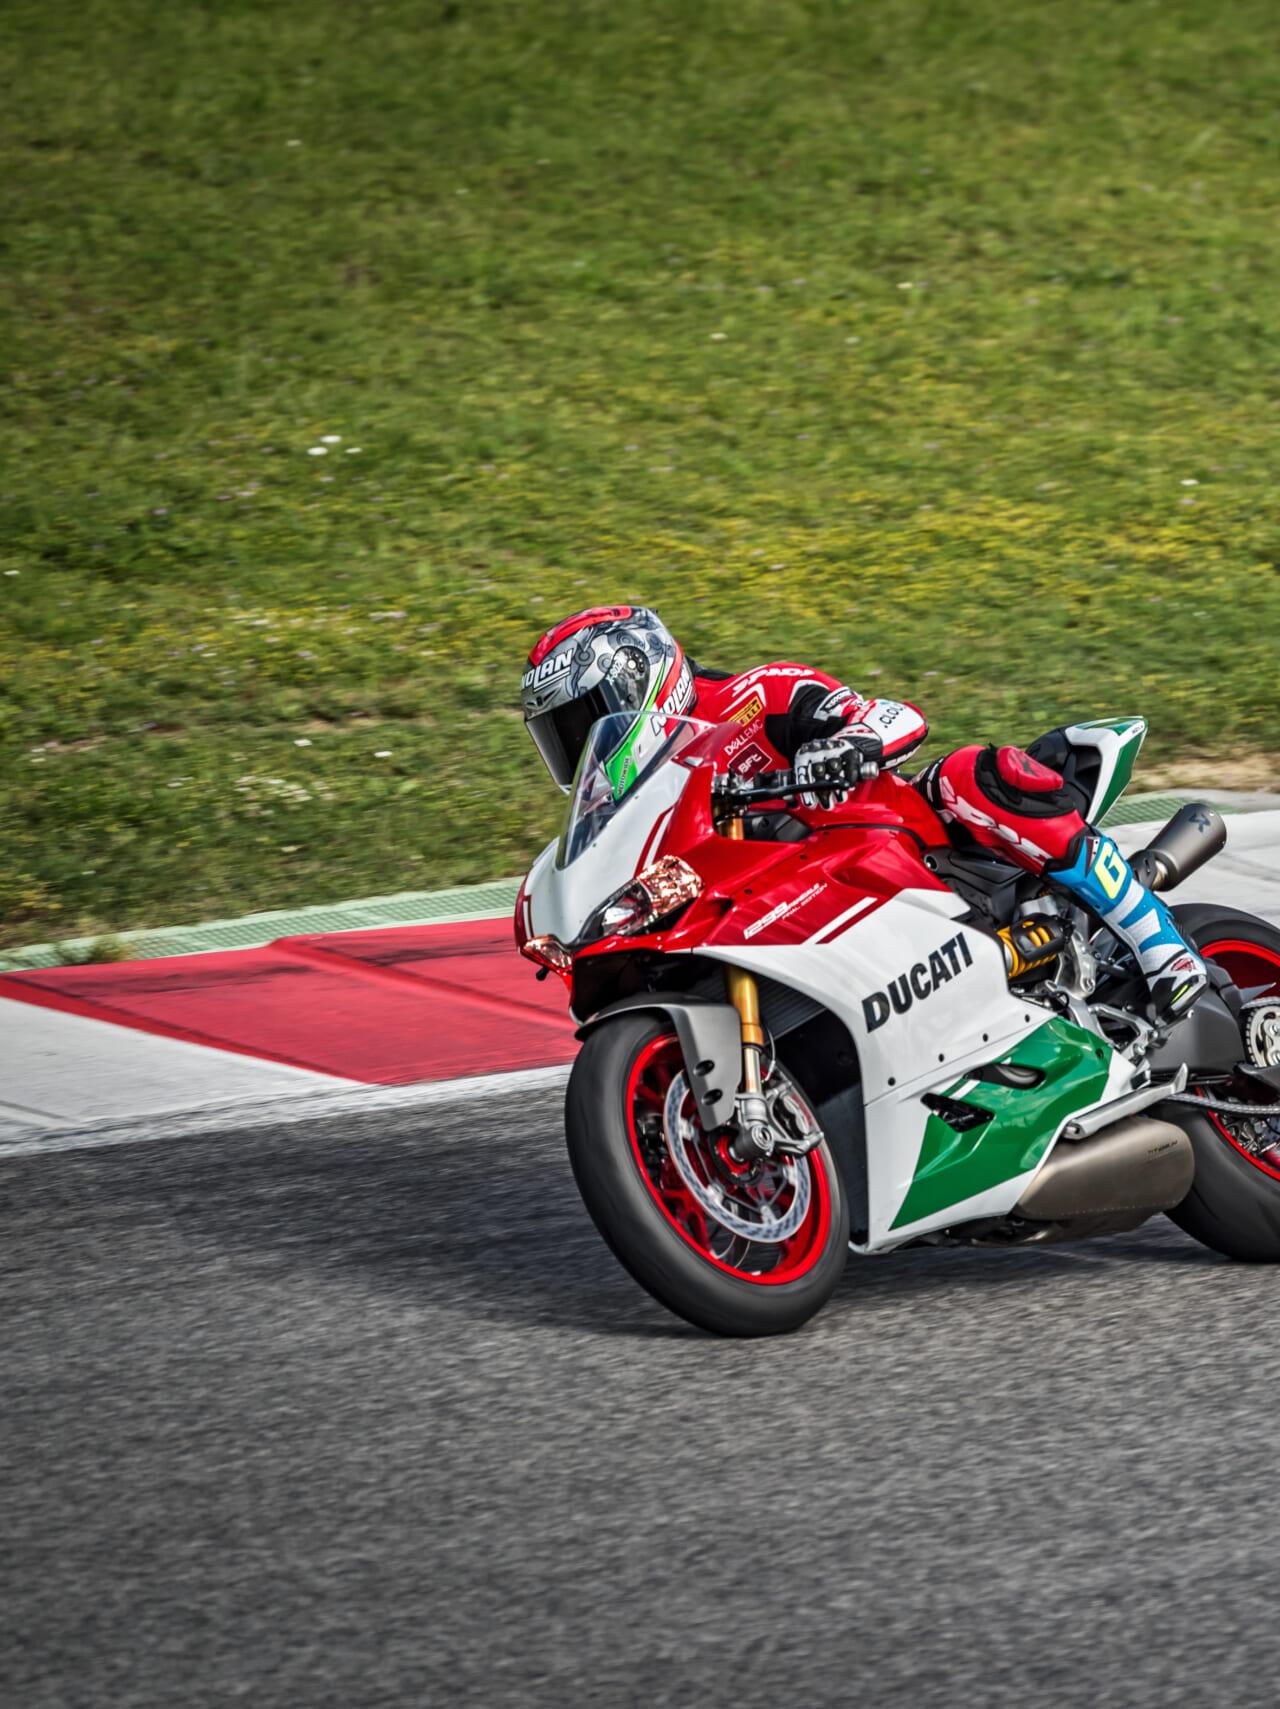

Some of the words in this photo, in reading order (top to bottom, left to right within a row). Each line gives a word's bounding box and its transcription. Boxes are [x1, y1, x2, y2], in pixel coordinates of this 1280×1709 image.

[521, 648, 574, 692] NOLAN
[650, 664, 692, 736] NOLAN
[743, 901, 789, 940] 1299
[861, 932, 974, 1034] DUCATI
